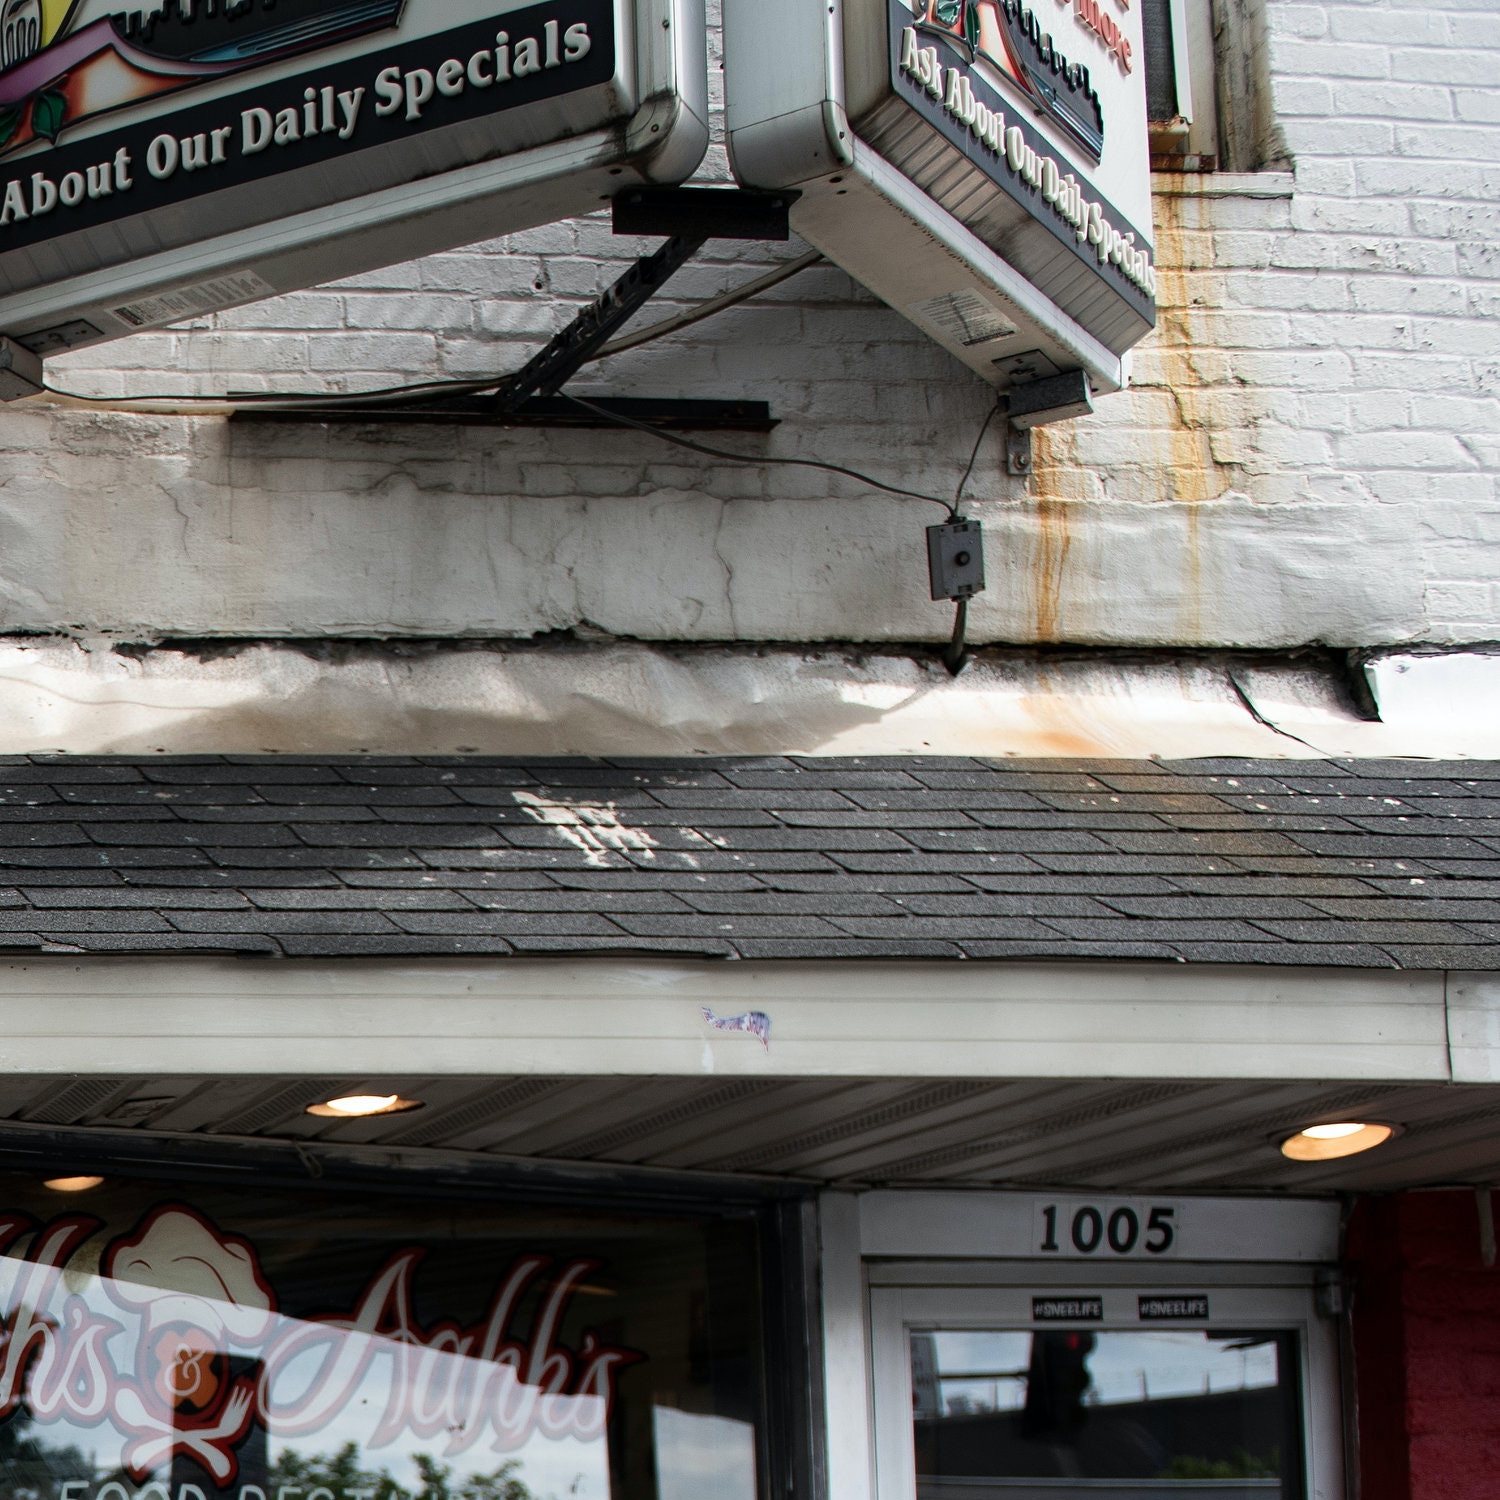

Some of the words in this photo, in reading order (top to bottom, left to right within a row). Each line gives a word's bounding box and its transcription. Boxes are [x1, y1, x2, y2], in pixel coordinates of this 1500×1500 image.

[0, 147, 133, 226] About
[146, 126, 232, 180] Our
[241, 86, 365, 155] Daily
[375, 20, 591, 121] Specials
[900, 27, 943, 100] Ask
[944, 68, 1006, 155] About
[1006, 126, 1043, 190] Our
[1042, 157, 1090, 242] Daily
[1088, 203, 1156, 297] Specials
[1041, 1205, 1175, 1253] 1005
